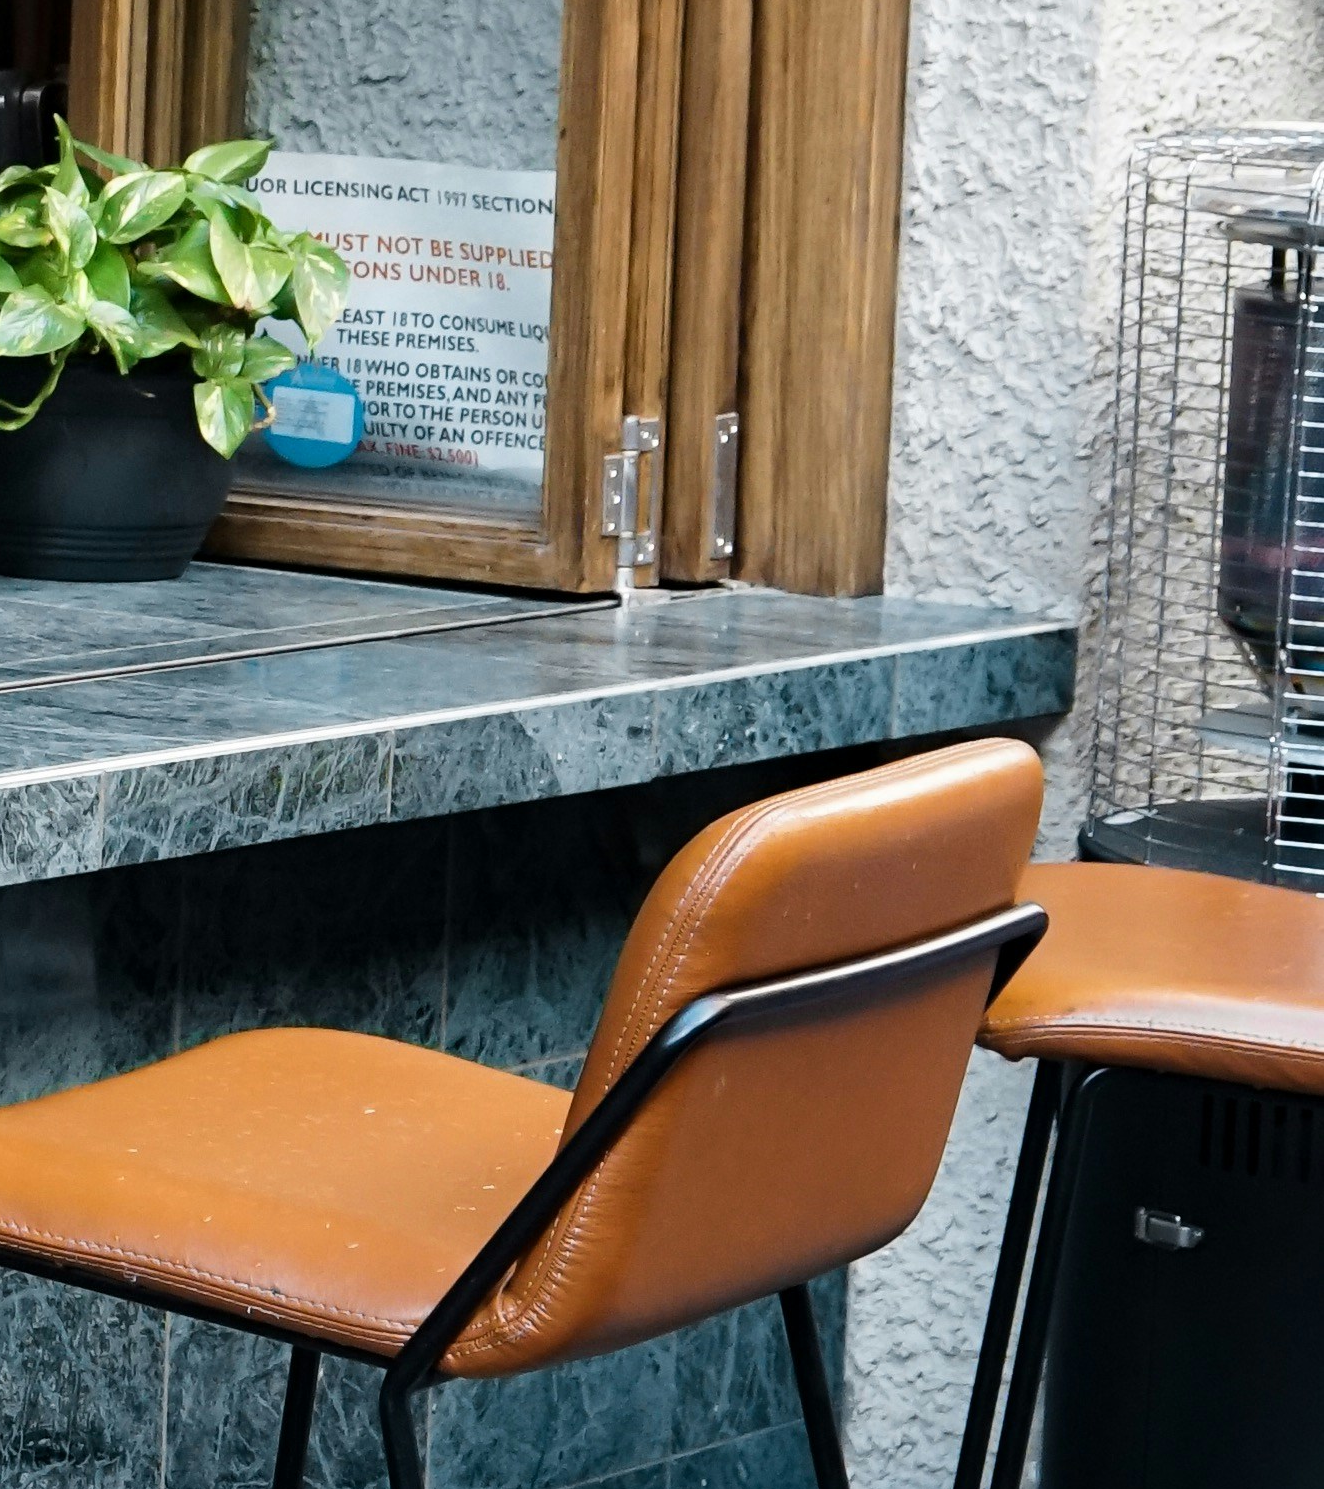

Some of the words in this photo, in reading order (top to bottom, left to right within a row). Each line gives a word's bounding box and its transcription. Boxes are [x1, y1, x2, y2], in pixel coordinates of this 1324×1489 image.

[245, 178, 287, 194] UOR
[293, 179, 393, 200] LICENSING
[397, 186, 430, 204] ACT
[437, 190, 467, 207] 1997
[471, 194, 553, 214] SECTION
[377, 235, 423, 255] NOT
[430, 239, 454, 259] BE
[459, 242, 553, 269] SUPPLIED
[409, 264, 481, 288] UNDER
[487, 271, 511, 292] 18.
[392, 311, 408, 327] 18
[411, 312, 434, 329] TO
[439, 314, 516, 337] CONSUME
[336, 328, 391, 347] THESE
[395, 332, 480, 353] PREMISES.
[346, 357, 362, 375] 18
[365, 359, 410, 377] WHO
[415, 363, 491, 383] OBTAINS
[496, 368, 518, 385] OR
[522, 372, 548, 388] CO
[366, 380, 450, 402] PREMISES,
[452, 386, 491, 403] AND
[495, 389, 528, 407] ANY
[395, 403, 416, 419] TO
[419, 404, 453, 422] THE
[460, 407, 527, 428] PERSON
[532, 414, 543, 430] U
[356, 439, 381, 455] AX.
[363, 420, 407, 438] UILTY
[414, 424, 437, 442] OF
[438, 427, 465, 444] AN
[470, 429, 545, 451] OFFENCE
